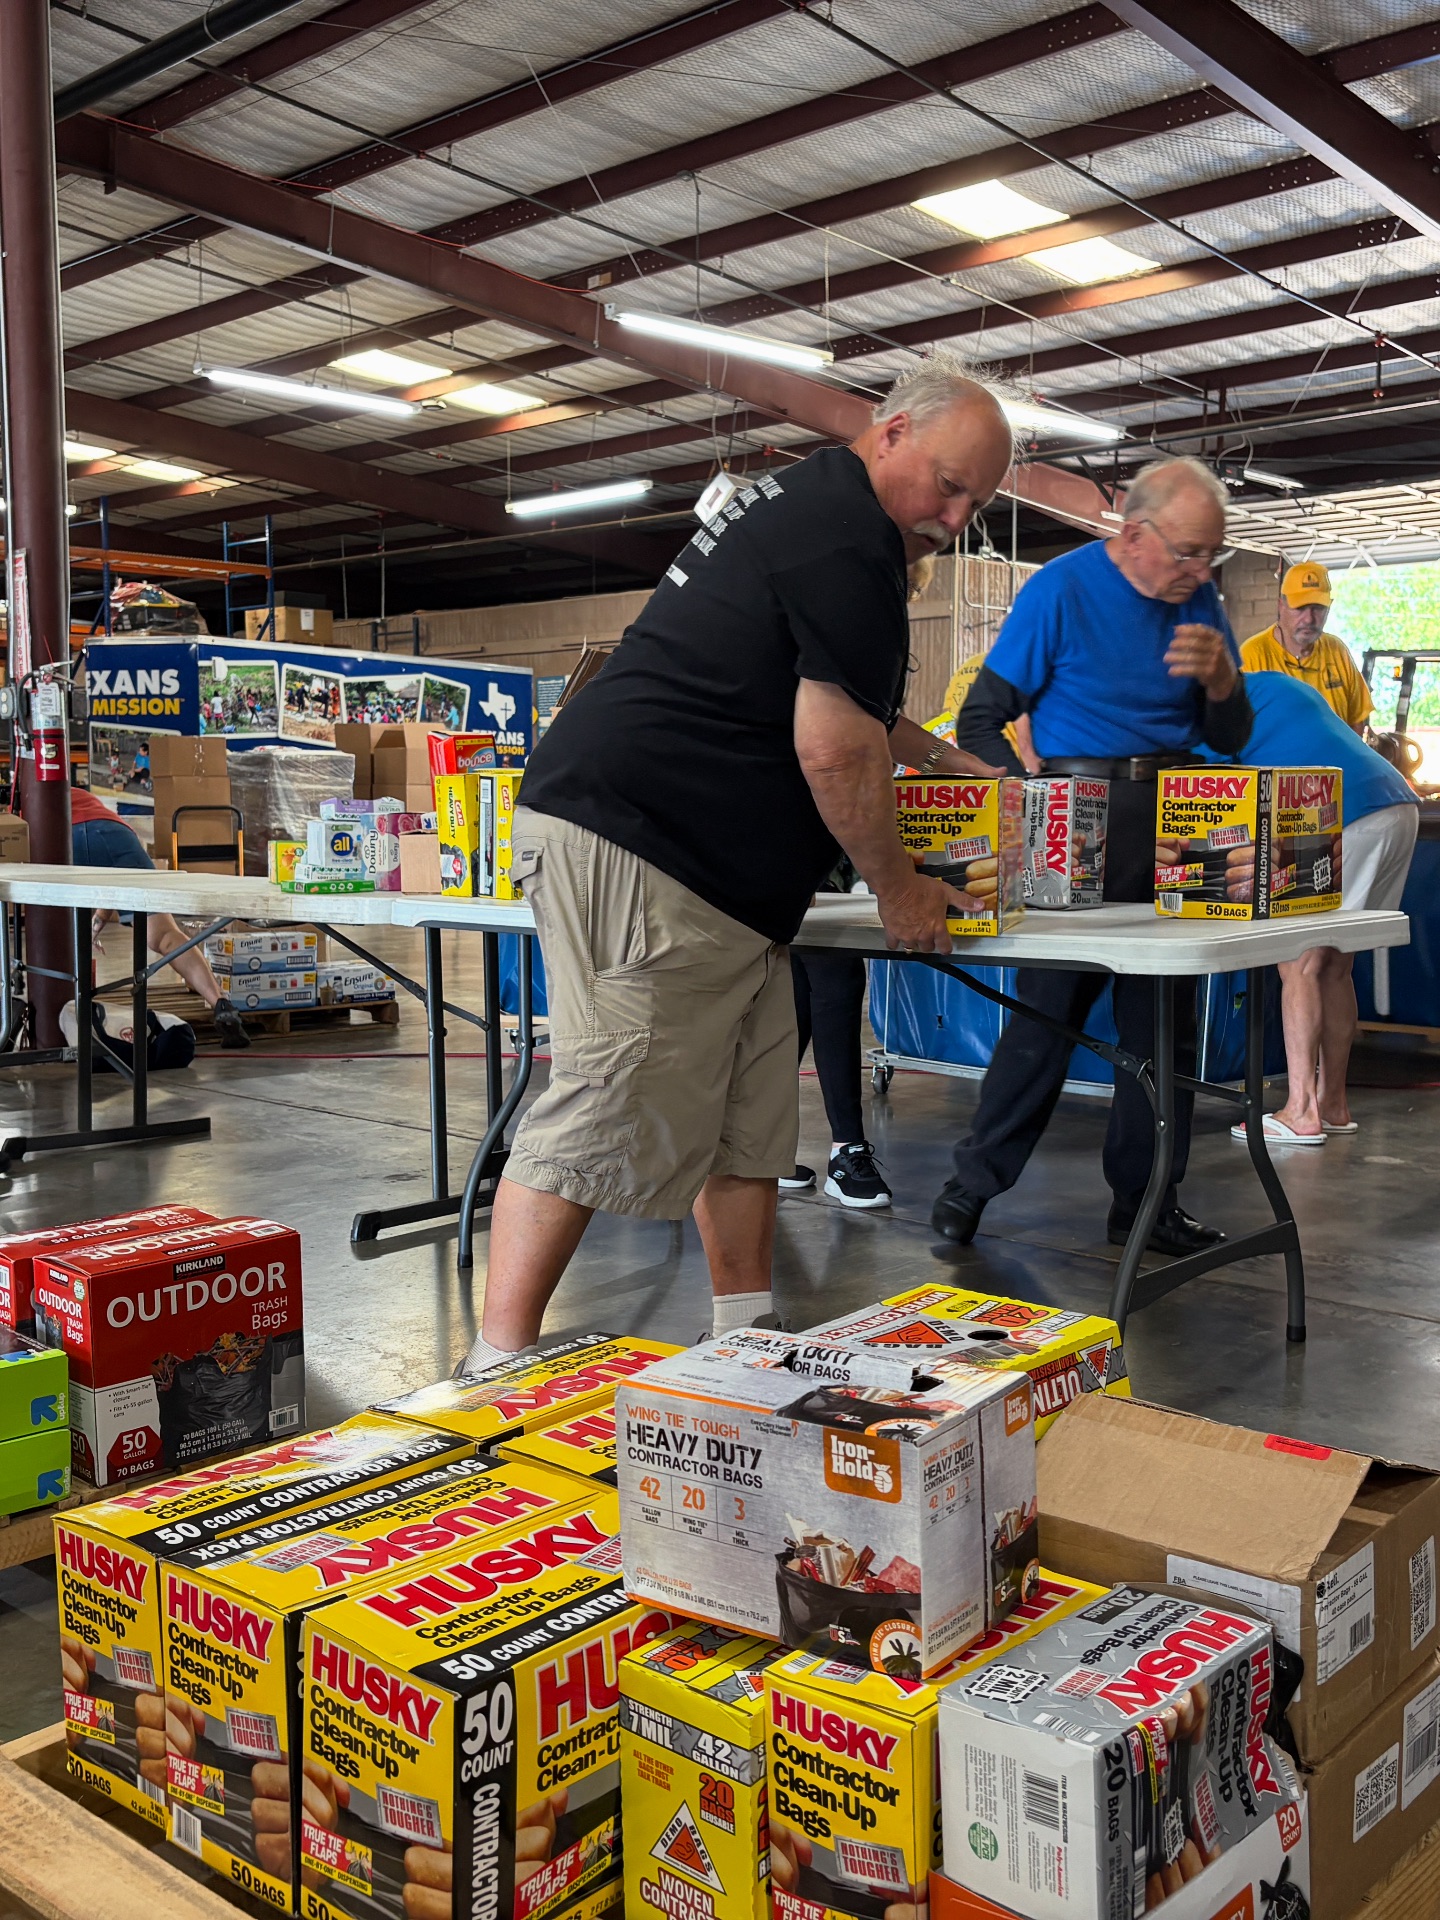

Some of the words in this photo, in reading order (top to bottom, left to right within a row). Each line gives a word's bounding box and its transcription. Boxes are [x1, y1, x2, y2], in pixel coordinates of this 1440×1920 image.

[92, 698, 181, 716] MISSION
[457, 753, 493, 768] bounce
[502, 785, 510, 810] GLAD
[896, 784, 991, 810] HUSKY
[1076, 781, 1108, 799] HUSKY
[1163, 776, 1249, 799] HUSKY
[1260, 773, 1272, 802] 50
[1277, 773, 1336, 810] HUSKY
[455, 800, 465, 826] GLAD
[1075, 797, 1107, 809] Contractor
[1162, 800, 1237, 812] Contractor
[896, 811, 977, 823] Contractor
[1046, 781, 1069, 877] HUSKY
[1075, 819, 1094, 832] Bags
[1162, 823, 1197, 836] Bags
[1276, 812, 1306, 823] Contractor
[1302, 820, 1317, 833] Bags
[333, 839, 350, 852] all
[368, 830, 379, 874] Downy
[1211, 834, 1246, 847] TOUGHER
[1259, 818, 1268, 886] CONTRACTOR
[951, 847, 988, 860] TOUGHER
[1156, 868, 1173, 876] TRUE
[1160, 873, 1181, 883] FLAPS
[1071, 893, 1082, 904] 20
[1206, 904, 1222, 916] 50
[1223, 908, 1248, 917] BAGS
[1258, 887, 1267, 914] PACK
[1272, 903, 1279, 913] 50
[240, 937, 263, 948] Ensure
[238, 975, 261, 986] Ensure
[344, 972, 374, 986] Ensure
[175, 1255, 224, 1273] KIRKLAND
[39, 1288, 83, 1319] OUTDOOR
[106, 1261, 287, 1328] OUTDOOR
[251, 1296, 288, 1315] TRASH
[66, 1316, 84, 1331] TRASH
[252, 1310, 288, 1330] Bags
[67, 1326, 84, 1345] Bags
[576, 1333, 609, 1345] 50
[813, 1365, 851, 1382] BAGS
[113, 1394, 131, 1403] closure
[113, 1405, 122, 1413] Fits
[190, 1428, 205, 1439] BAGS
[625, 1403, 661, 1424] WING
[690, 1417, 741, 1440] TOUGH
[122, 1430, 147, 1454] 50
[123, 1448, 147, 1460] GALLON
[626, 1420, 699, 1457] HEAVY
[706, 1438, 763, 1471] DUTY
[830, 1434, 875, 1459] Iron-
[106, 1430, 335, 1510] HUSKY
[117, 1465, 128, 1477] 70
[130, 1460, 155, 1475] BAGS
[446, 1458, 489, 1477] 50
[627, 1445, 720, 1480] CONTRACTOR
[723, 1467, 763, 1490] BAGS
[831, 1451, 875, 1482] Hold
[923, 1456, 953, 1483] HEAVY
[954, 1441, 975, 1468] DUTY
[923, 1467, 960, 1493] CONTRACTOR
[960, 1456, 976, 1475] BAGS
[155, 1521, 202, 1545] 50
[398, 1437, 452, 1464] PACK
[639, 1475, 661, 1501] 42
[681, 1484, 706, 1511] 20
[734, 1497, 746, 1521] 3
[928, 1493, 939, 1510] 42
[945, 1486, 956, 1502] 20
[254, 1487, 398, 1540] CONTRACTOR
[641, 1506, 662, 1518] GALLON
[645, 1514, 659, 1524] BAGS
[682, 1516, 696, 1526] WING
[310, 1486, 561, 1589] HUSKY
[688, 1524, 703, 1535] BAGS
[732, 1536, 750, 1547] THICK
[735, 1530, 745, 1539] MIL
[58, 1527, 148, 1604] HUSKY
[360, 1512, 610, 1628] HUSKY
[544, 1574, 602, 1603] Bags
[1173, 1575, 1186, 1585] FBA
[1192, 1575, 1207, 1584] PLEASE
[1207, 1578, 1219, 1586] LEAVE
[1228, 1583, 1239, 1591] LABEL
[61, 1571, 138, 1622] Contractor
[1108, 1586, 1145, 1611] 20
[168, 1576, 274, 1664] HUSKY
[415, 1586, 538, 1640] Contractor
[64, 1611, 101, 1645] Bags
[168, 1622, 260, 1684] Contractor
[440, 1653, 495, 1681] 50
[491, 1629, 555, 1663] COUNT
[1097, 1610, 1254, 1716] HUSKY
[170, 1667, 212, 1706] Bags
[975, 1674, 999, 1692] GALLON
[1005, 1670, 1026, 1680] 2
[64, 1691, 82, 1709] TRUE
[311, 1633, 442, 1744] HUSKY
[70, 1706, 91, 1725] FLAPS
[310, 1684, 420, 1765] Contractor
[461, 1681, 514, 1756] 50
[628, 1699, 673, 1728] STRENGTH
[1246, 1646, 1281, 1797] HUSKY
[770, 1690, 898, 1772] HUSKY
[1234, 1658, 1258, 1818] Contractor
[310, 1735, 361, 1780] Bags
[697, 1732, 733, 1766] 42
[1150, 1730, 1163, 1761] FLAPS
[168, 1754, 187, 1775] TRUE
[186, 1761, 200, 1779] TIE
[461, 1740, 514, 1783] COUNT
[632, 1749, 644, 1761] ALL
[643, 1752, 654, 1764] THE
[654, 1756, 675, 1776] OTHER
[637, 1760, 654, 1775] BAGS
[655, 1766, 670, 1782] JUST
[692, 1752, 740, 1780] GALLON
[772, 1732, 900, 1807] Contractor
[1102, 1743, 1127, 1792] 20
[69, 1754, 85, 1780] 50
[85, 1772, 112, 1796] BAGS
[636, 1767, 651, 1783] TALK
[651, 1772, 671, 1792] TRASH
[700, 1799, 735, 1825] BAGS
[775, 1789, 832, 1838] Bags
[1107, 1793, 1121, 1843] BAGS
[1278, 1805, 1297, 1834] 20
[326, 1830, 343, 1851] TIE
[660, 1816, 684, 1849] DEMO
[1282, 1825, 1301, 1848] COUNT
[309, 1841, 338, 1865] FLAPS
[688, 1824, 714, 1875] BAGS
[230, 1858, 252, 1888] 50
[253, 1882, 286, 1908] BAGS
[1056, 1846, 1064, 1898] Poly-America
[660, 1870, 713, 1916] WOVEN
[773, 1889, 803, 1914] TRUE
